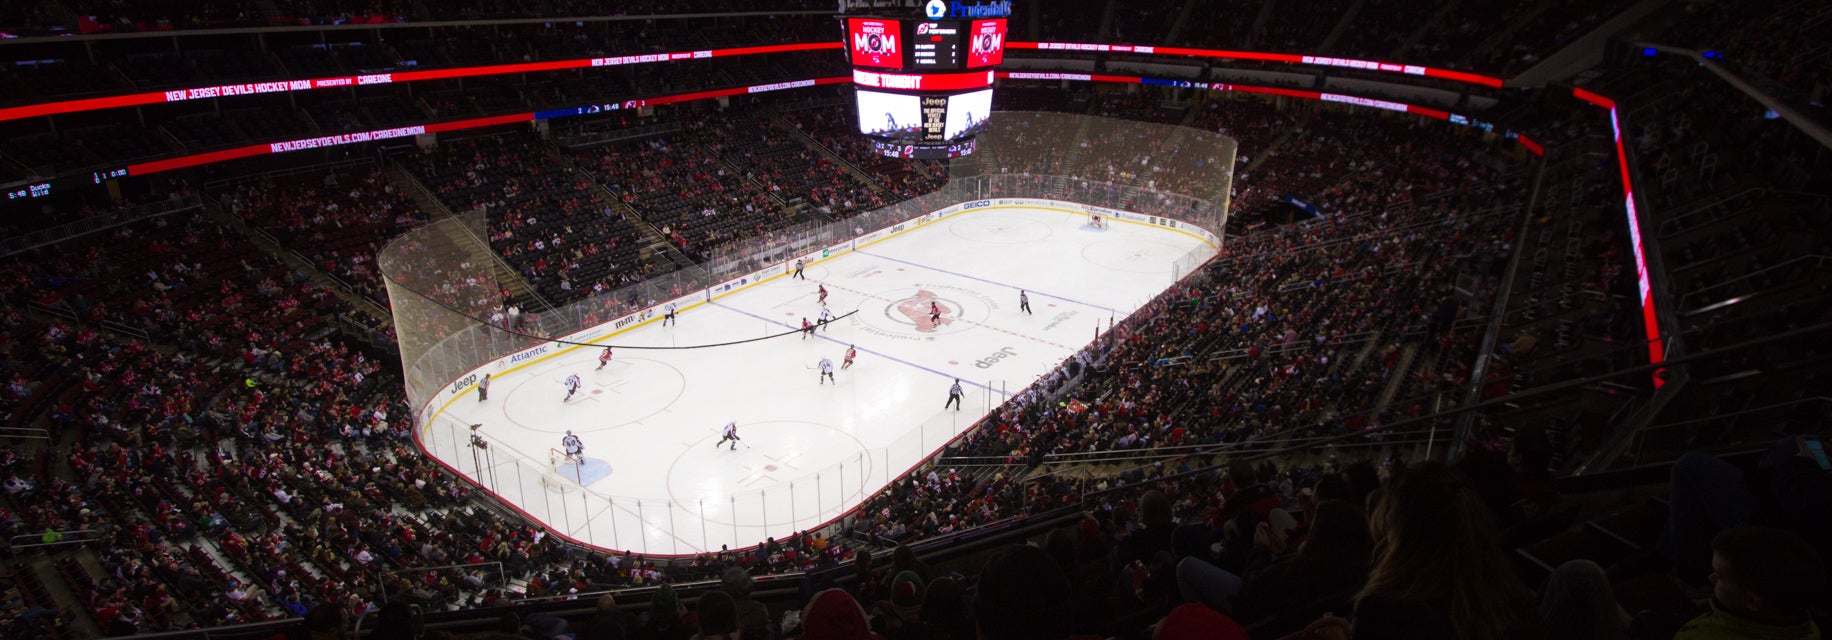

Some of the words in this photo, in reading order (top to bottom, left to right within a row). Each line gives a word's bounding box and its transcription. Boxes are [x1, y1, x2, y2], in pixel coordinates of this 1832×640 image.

[166, 90, 188, 102] NEW
[188, 87, 220, 100] JERSEY
[221, 85, 254, 97] DEVILS
[254, 82, 289, 94] HOCKEY
[290, 80, 311, 92] MOM
[357, 73, 392, 85] CAREONE
[922, 97, 947, 107] Jeep
[271, 125, 425, 153] NEWJERSEYDEVILS.COM/CAREONEMOM
[30, 183, 51, 192] Ducks
[31, 189, 49, 198] Wild
[964, 200, 990, 209] GEICO
[890, 224, 905, 234] Jeep
[511, 345, 548, 363] Atlantic
[975, 346, 1018, 369] Jeep
[451, 373, 477, 394] Jeep
